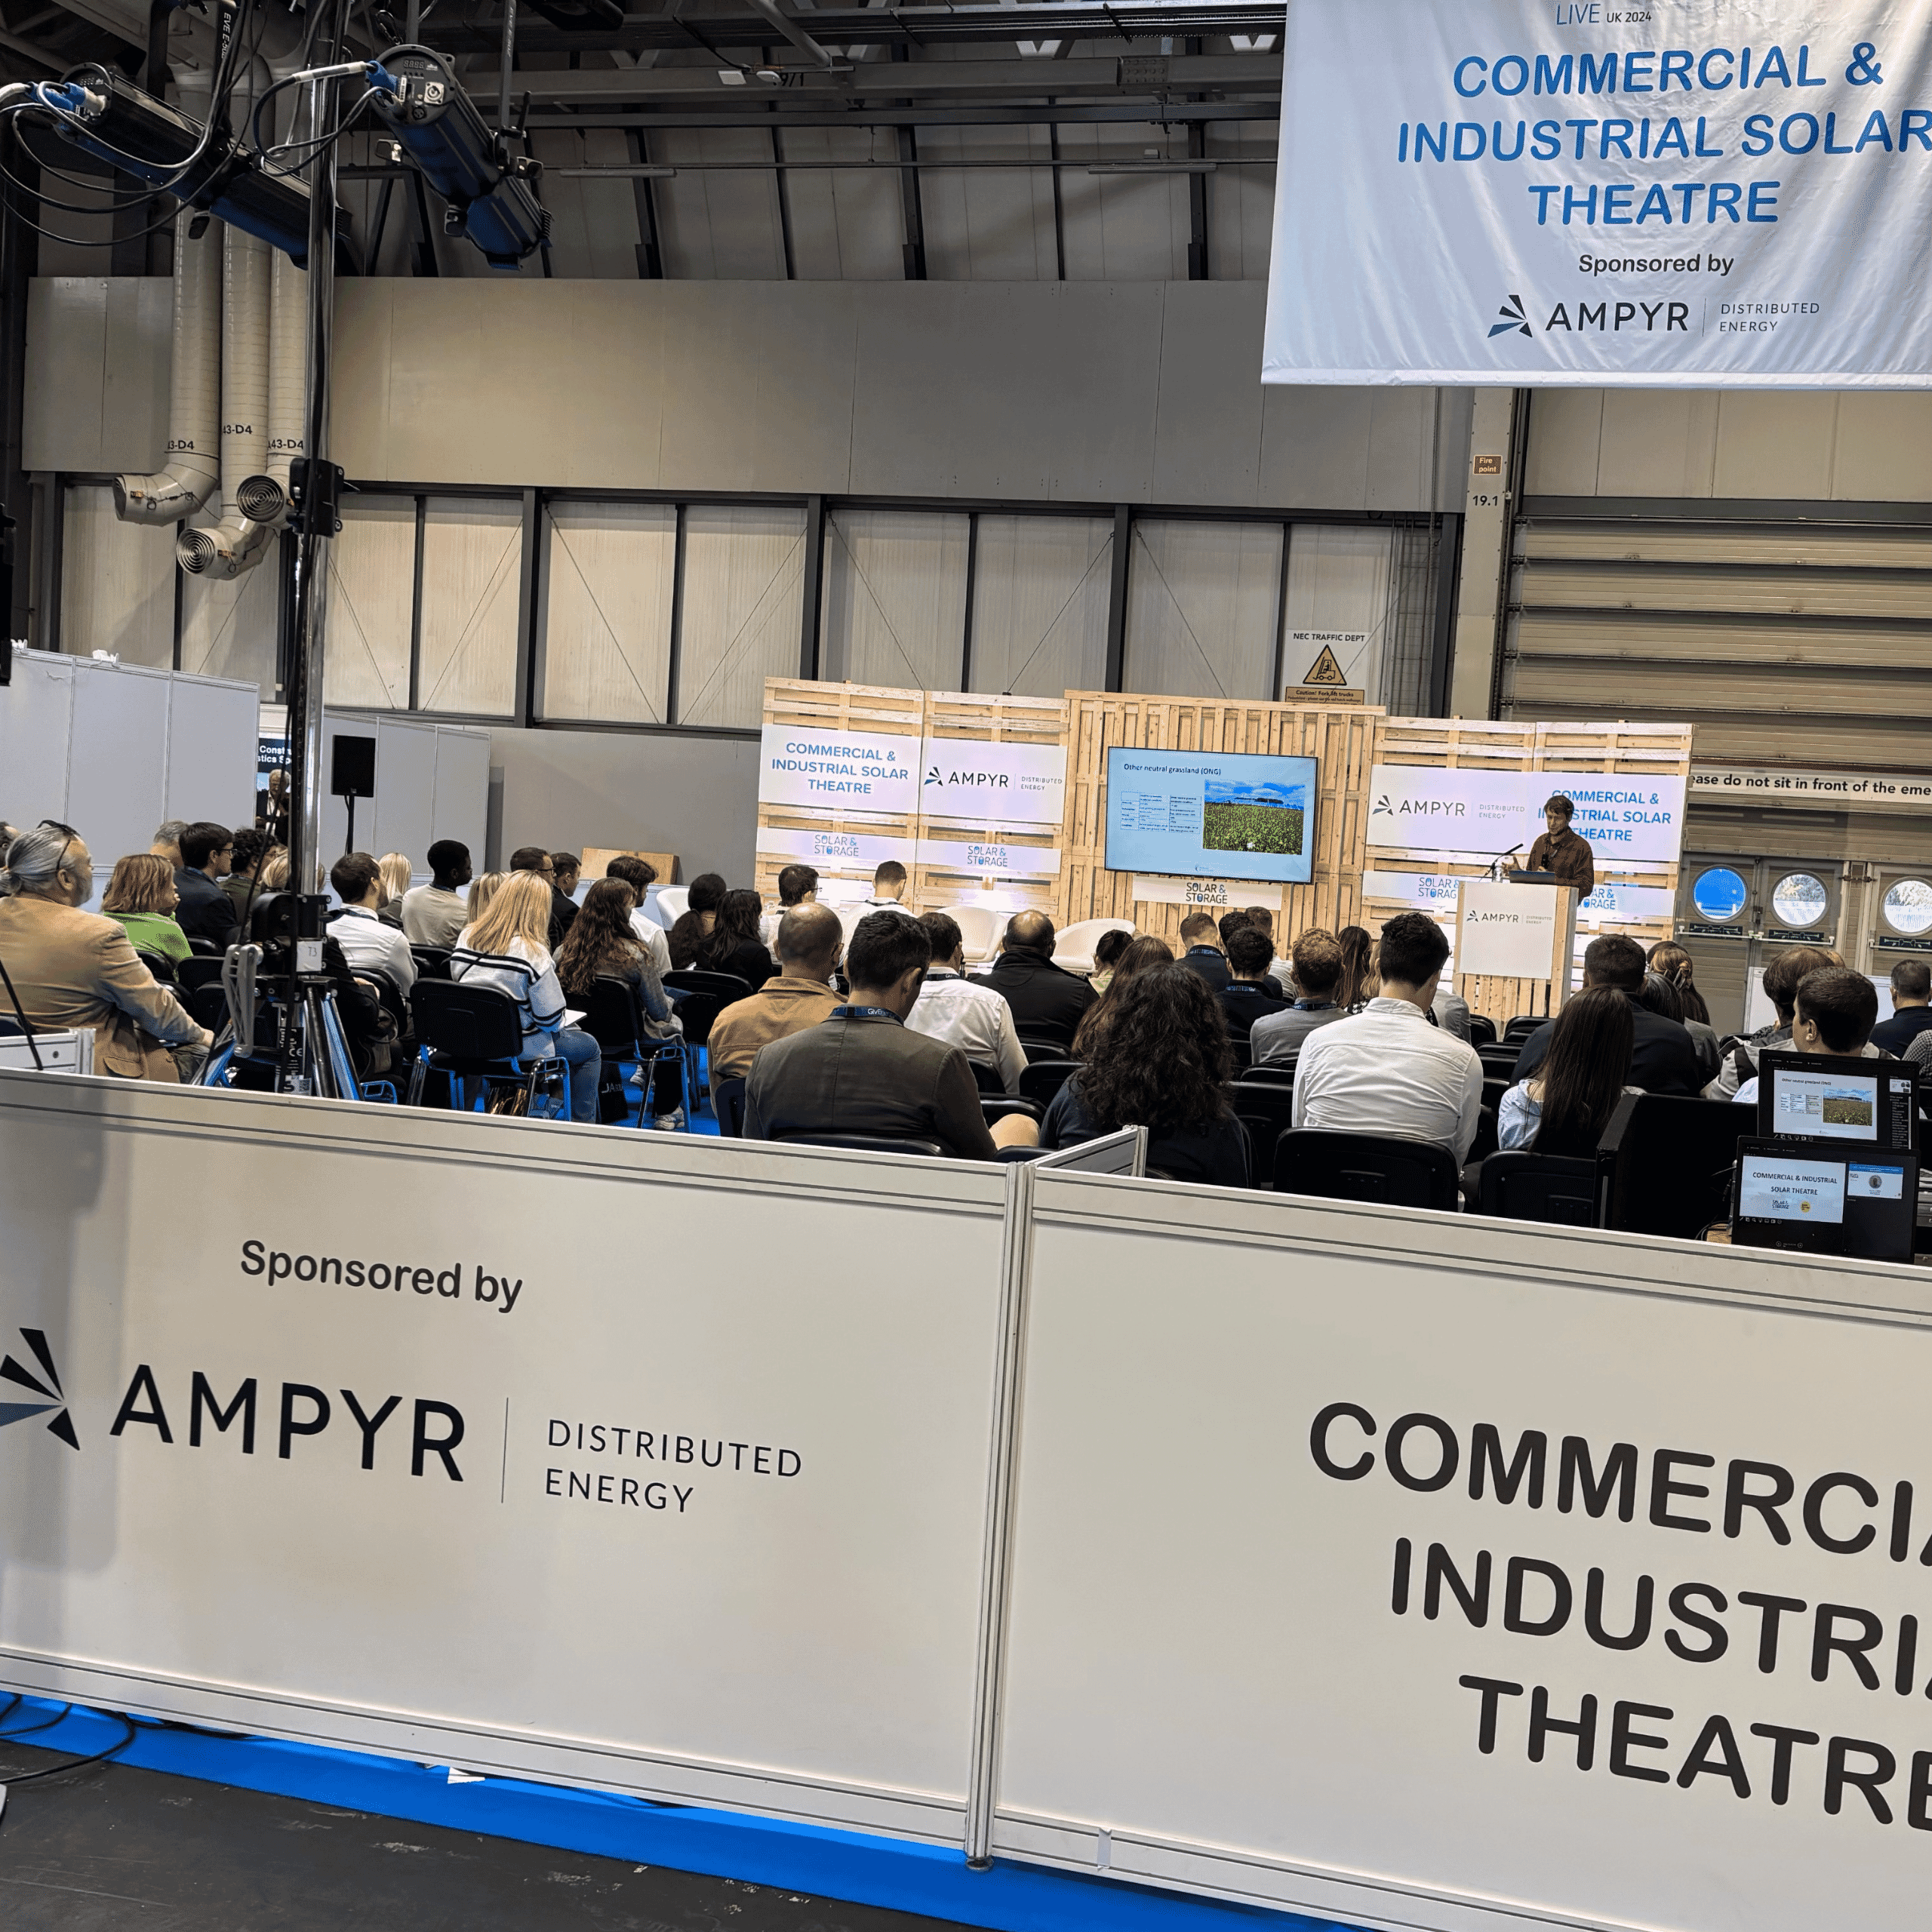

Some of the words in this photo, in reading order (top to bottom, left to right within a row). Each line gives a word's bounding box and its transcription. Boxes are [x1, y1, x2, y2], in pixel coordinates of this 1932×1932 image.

[1556, 3, 1601, 25] LIVE
[1607, 12, 1623, 23] UK
[1625, 11, 1652, 23] 2024
[222, 12, 232, 32] EVE
[1454, 45, 1827, 98] COMMERCIAL
[1844, 42, 1884, 86] &
[1397, 116, 1724, 164] INDUSTRIAL
[1741, 109, 1932, 158] SOLAR
[1527, 180, 1781, 226] THEATRE
[1579, 254, 1702, 277] Sponsored
[1707, 254, 1734, 276] by
[1720, 302, 1821, 317] DISTRIBUTED
[1545, 302, 1690, 334] AMPYR
[1719, 319, 1779, 334] ENERGY
[1478, 466, 1497, 474] point
[1472, 495, 1499, 506] 19.1
[1312, 633, 1343, 641] TRAFFIC
[786, 743, 882, 761] COMMERCIAL
[887, 751, 897, 761] &
[771, 758, 857, 777] INDUSTRIAL
[861, 766, 909, 780] SOLAR
[1124, 763, 1143, 771] Other
[1144, 764, 1168, 773] neutral
[1168, 765, 1200, 776] grassland
[1201, 767, 1222, 776] (ONG)
[808, 779, 872, 795] THEATRE
[948, 772, 1009, 789] AMPYR
[1020, 776, 1063, 784] DISTRIBUTED
[1724, 774, 1741, 786] do
[1746, 777, 1770, 788] not
[1774, 777, 1791, 789] sit
[1795, 778, 1807, 789] in
[1813, 778, 1848, 792] front
[1853, 780, 1869, 792] of
[1873, 782, 1896, 794] the
[1650, 792, 1659, 805] &
[1399, 799, 1466, 817] AMPYR
[1479, 804, 1525, 813] DISTRIBUTED
[1623, 811, 1671, 824] SOLAR
[814, 834, 848, 846] SOLAR
[850, 837, 857, 847] &
[814, 844, 860, 857] STORAGE
[968, 845, 998, 856] SOLAR
[1000, 848, 1007, 857] &
[967, 855, 1008, 867] STORAGE
[1186, 882, 1217, 894] SOLAR
[1219, 884, 1226, 894] &
[1419, 877, 1451, 888] SOLAR
[1186, 892, 1228, 904] STORAGE
[1418, 888, 1457, 899] STORAG
[1580, 898, 1616, 910] ORAGE
[1481, 913, 1519, 923] AMPYR
[1753, 1172, 1794, 1180] COMMERCIAL
[1802, 1176, 1838, 1184] INDUSTRIAL
[240, 1239, 461, 1299] Sponsored
[474, 1265, 524, 1314] by
[110, 1364, 466, 1482] AMPYR
[547, 1419, 802, 1479] DISTRIBUTED
[544, 1468, 695, 1515] ENERGY
[1309, 1401, 1932, 1567] COMMERCI
[1392, 1537, 1932, 1699] INDUSTRI
